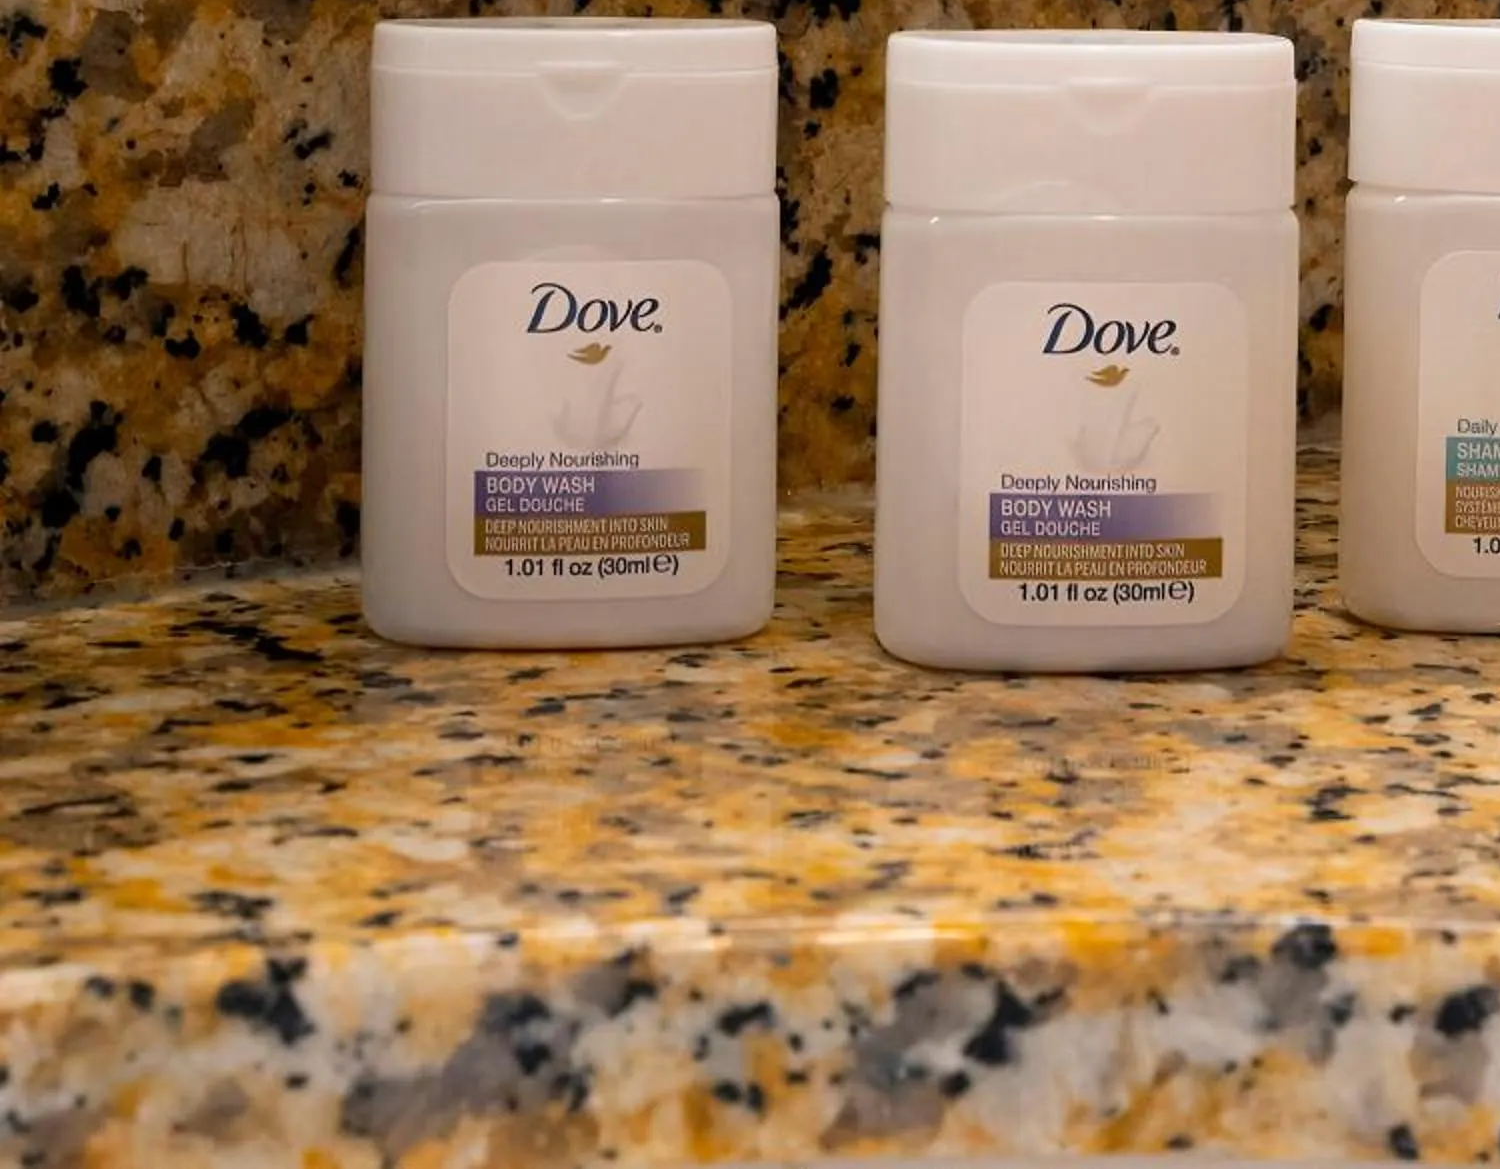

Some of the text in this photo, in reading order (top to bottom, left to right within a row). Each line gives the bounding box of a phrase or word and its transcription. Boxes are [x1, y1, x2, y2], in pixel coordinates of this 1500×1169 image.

[527, 282, 660, 334] Dove
[1042, 303, 1177, 355] Dove
[1458, 419, 1498, 436] Daily
[486, 451, 639, 470] Deeply Nourishing
[486, 476, 595, 494] BODY WASH
[1001, 474, 1157, 493] Deeply Nourishing
[485, 497, 585, 512] GEL DOUCHE
[1001, 499, 1111, 518] BODY WASH
[1001, 521, 1101, 536] GEL DOUCHE
[505, 558, 543, 576] 1.01
[552, 558, 563, 576] fl
[569, 562, 593, 576] oz
[1019, 582, 1059, 601] 1.01
[1067, 582, 1079, 601] fl
[1084, 587, 1107, 601] oz
